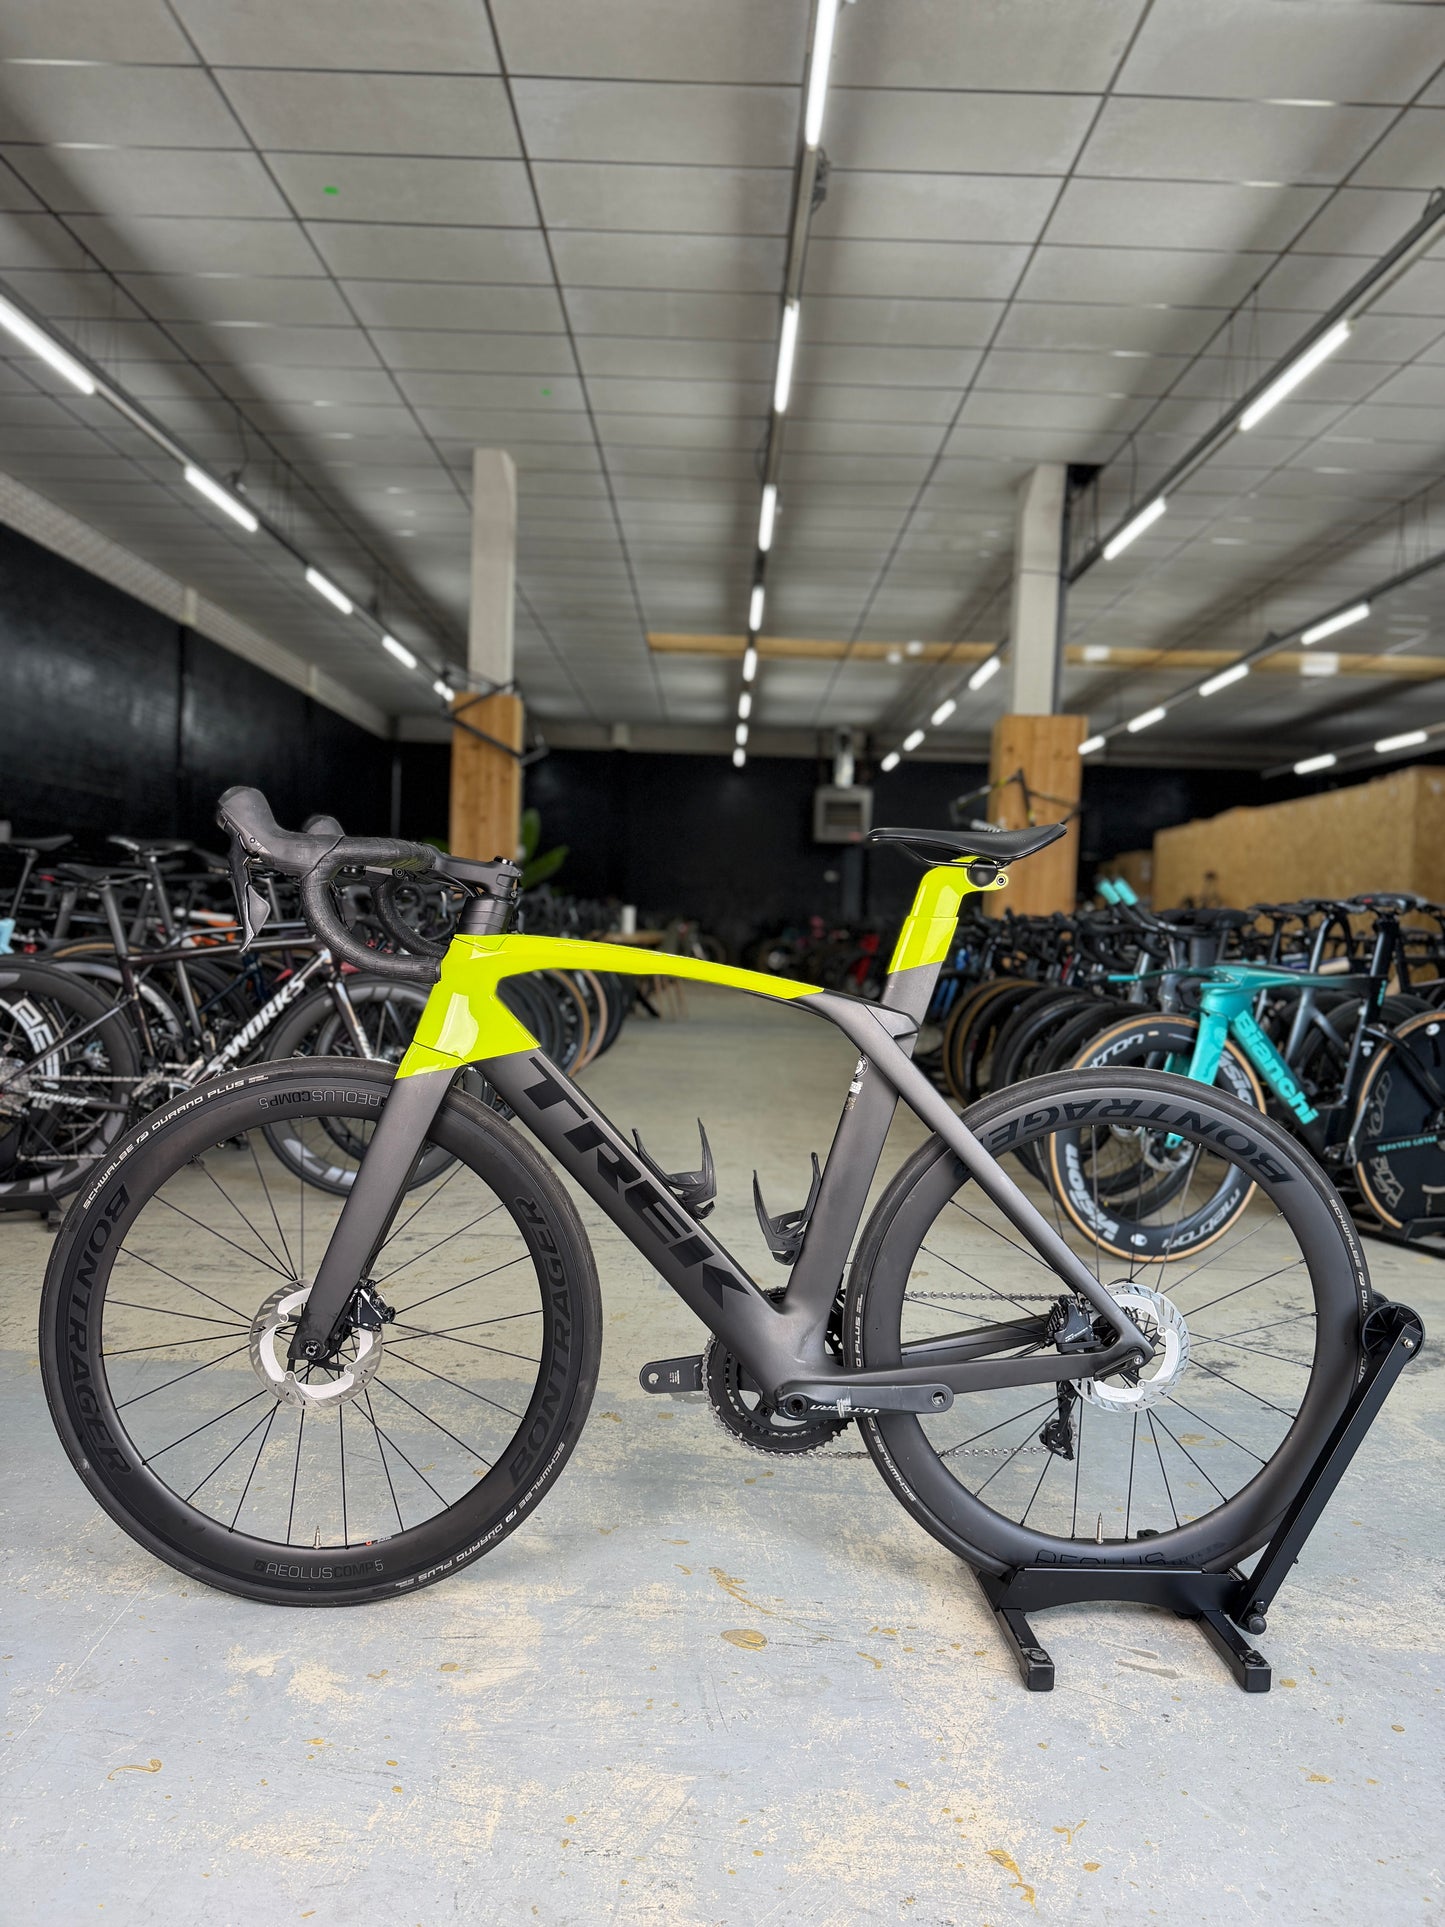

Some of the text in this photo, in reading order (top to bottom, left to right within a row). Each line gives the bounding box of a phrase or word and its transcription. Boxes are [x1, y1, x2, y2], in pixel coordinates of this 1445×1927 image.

[1089, 1033, 1144, 1068] tron
[1219, 1050, 1253, 1106] isio
[1234, 1010, 1319, 1124] Bianchi
[83, 1080, 244, 1210] SCHWALBE DURANO PLUS
[523, 1057, 751, 1310] TREK
[979, 1098, 1294, 1184] BONTRAGE
[1162, 1187, 1241, 1249] metron
[1329, 1198, 1361, 1268] SCHWALBE
[69, 1184, 132, 1476] BONTRAGER
[509, 1196, 571, 1487] BONTRAGER
[418, 1442, 565, 1581] SCHWALBE DURANO PLUS
[873, 1435, 916, 1502] SCHWALBE
